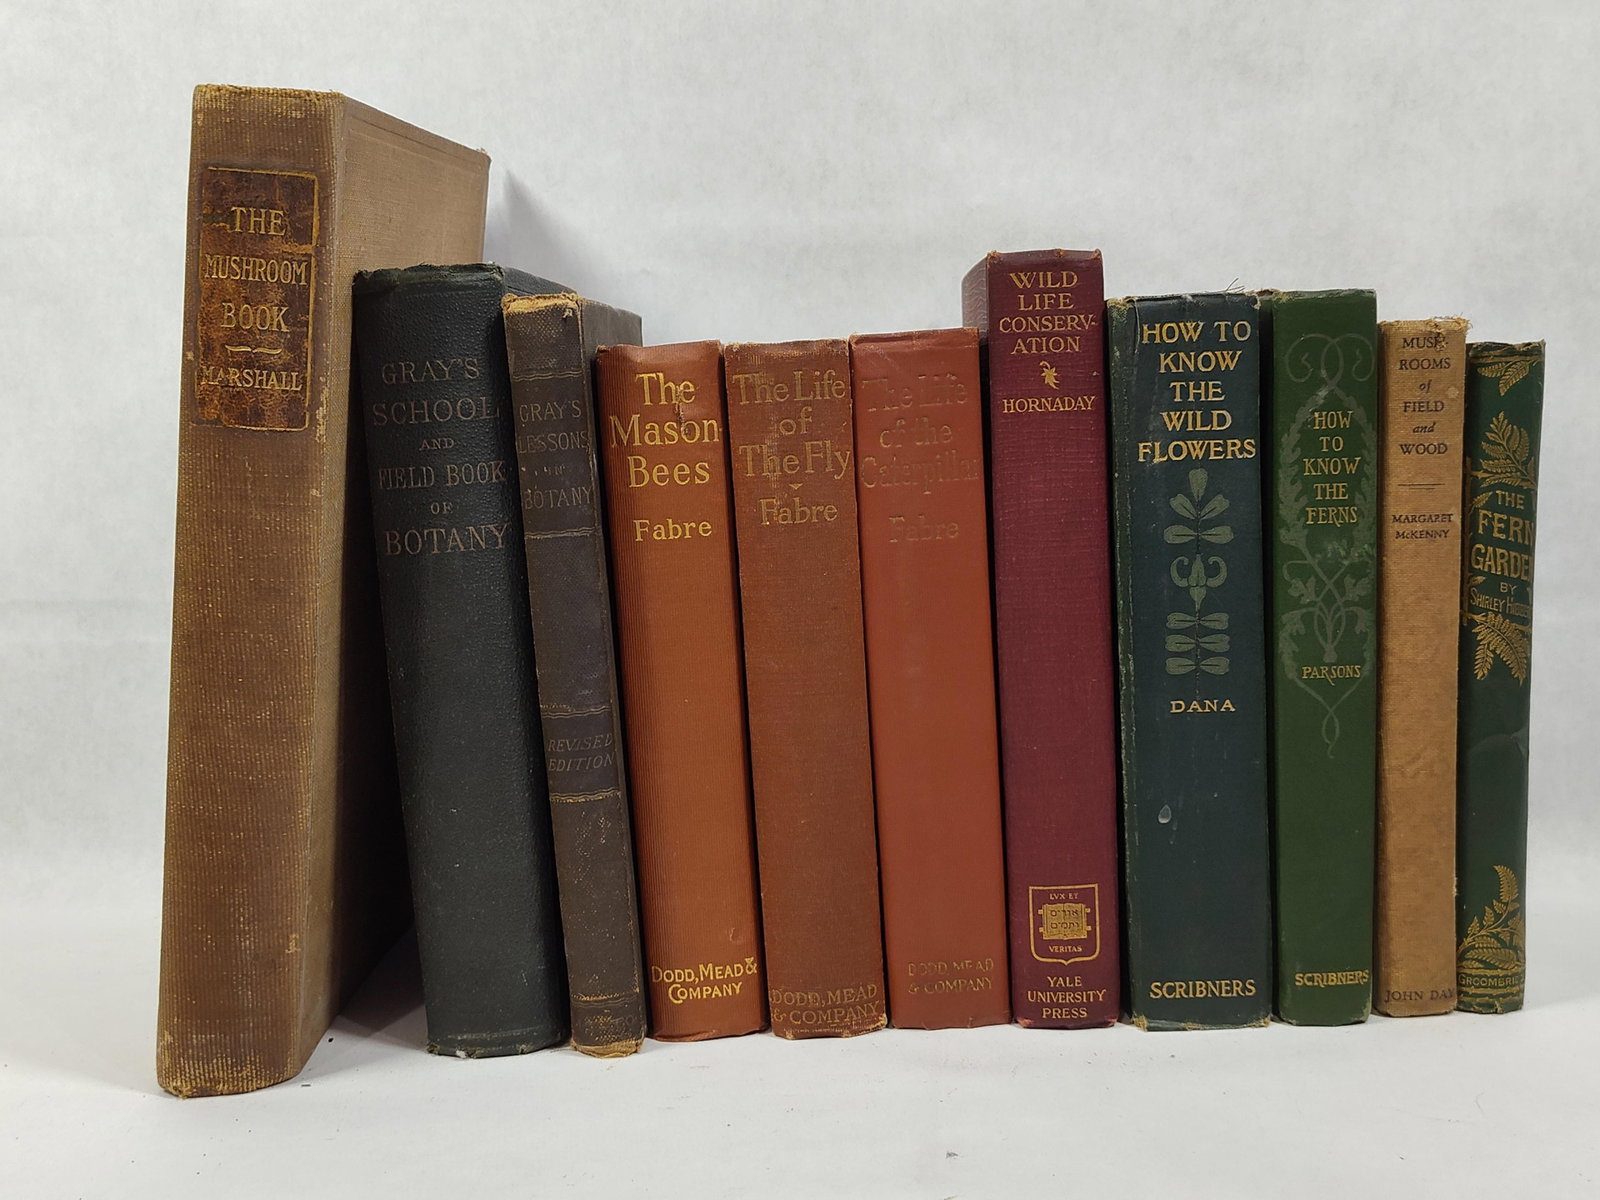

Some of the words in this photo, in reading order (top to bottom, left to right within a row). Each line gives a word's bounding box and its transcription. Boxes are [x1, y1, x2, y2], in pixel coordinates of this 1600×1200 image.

[231, 206, 286, 236] THE
[204, 254, 308, 285] MUSHROOM
[1010, 271, 1078, 289] WILD
[1018, 293, 1074, 311] LIFE
[221, 302, 290, 332] BOOK
[999, 314, 1096, 333] CONSERV-
[1141, 321, 1205, 344] HOW
[1214, 321, 1252, 342] TO
[1010, 336, 1080, 355] ATION
[1159, 350, 1242, 373] KNOW
[1399, 358, 1451, 371] ROOMS
[201, 366, 302, 391] MARSHALL
[382, 358, 480, 385] GRAY'S
[635, 371, 695, 405] The
[732, 372, 789, 405] The
[793, 369, 846, 401] Life
[1169, 380, 1226, 402] THE
[1419, 380, 1433, 394] of
[372, 396, 499, 426] SCHOOL
[520, 400, 581, 422] GRAY'S
[1002, 396, 1096, 413] HORNADAY
[1403, 401, 1445, 413] FIELD
[779, 406, 812, 435] of
[1159, 410, 1232, 432] WILD
[1313, 411, 1353, 430] HOW
[1412, 422, 1436, 434] and
[609, 414, 720, 447] Mason
[419, 438, 455, 450] AND
[518, 431, 588, 454] LESSONS
[1138, 439, 1256, 463] FLOWERS
[1319, 436, 1344, 452] TO
[1399, 443, 1448, 455] WOOD
[738, 445, 800, 477] The
[804, 440, 850, 480] Fly
[1303, 457, 1361, 476] KNOW
[378, 466, 434, 490] FIELD
[446, 461, 506, 486] BOOK
[627, 455, 710, 488] Bees
[525, 486, 593, 510] BOTANY
[1313, 483, 1349, 500] THE
[1495, 490, 1525, 509] THE
[430, 502, 453, 515] OF
[760, 497, 838, 526] Fabre
[1305, 506, 1358, 527] FERNS
[1391, 513, 1453, 524] MARGARET
[1477, 509, 1535, 546] FERN
[385, 522, 512, 555] BOTANY
[633, 519, 712, 542] Fabre
[1395, 529, 1450, 540] McKENNY
[1500, 582, 1519, 595] BY
[1302, 665, 1361, 686] PARSONS
[1170, 699, 1236, 713] DANA
[548, 733, 613, 752] REVISED
[549, 752, 614, 771] EDITION
[1048, 945, 1082, 953] VERITAS
[1047, 976, 1083, 988] YALE
[1295, 970, 1369, 988] SCRIBNERS
[1027, 989, 1106, 1003] UNIVERSITY
[1149, 979, 1257, 999] SCRIBNERS
[1384, 990, 1424, 1003] JOHN
[1431, 988, 1455, 1000] DAY
[773, 1008, 786, 1022] &
[790, 1000, 880, 1024] COMPANY
[1042, 1007, 1088, 1019] PRESS
